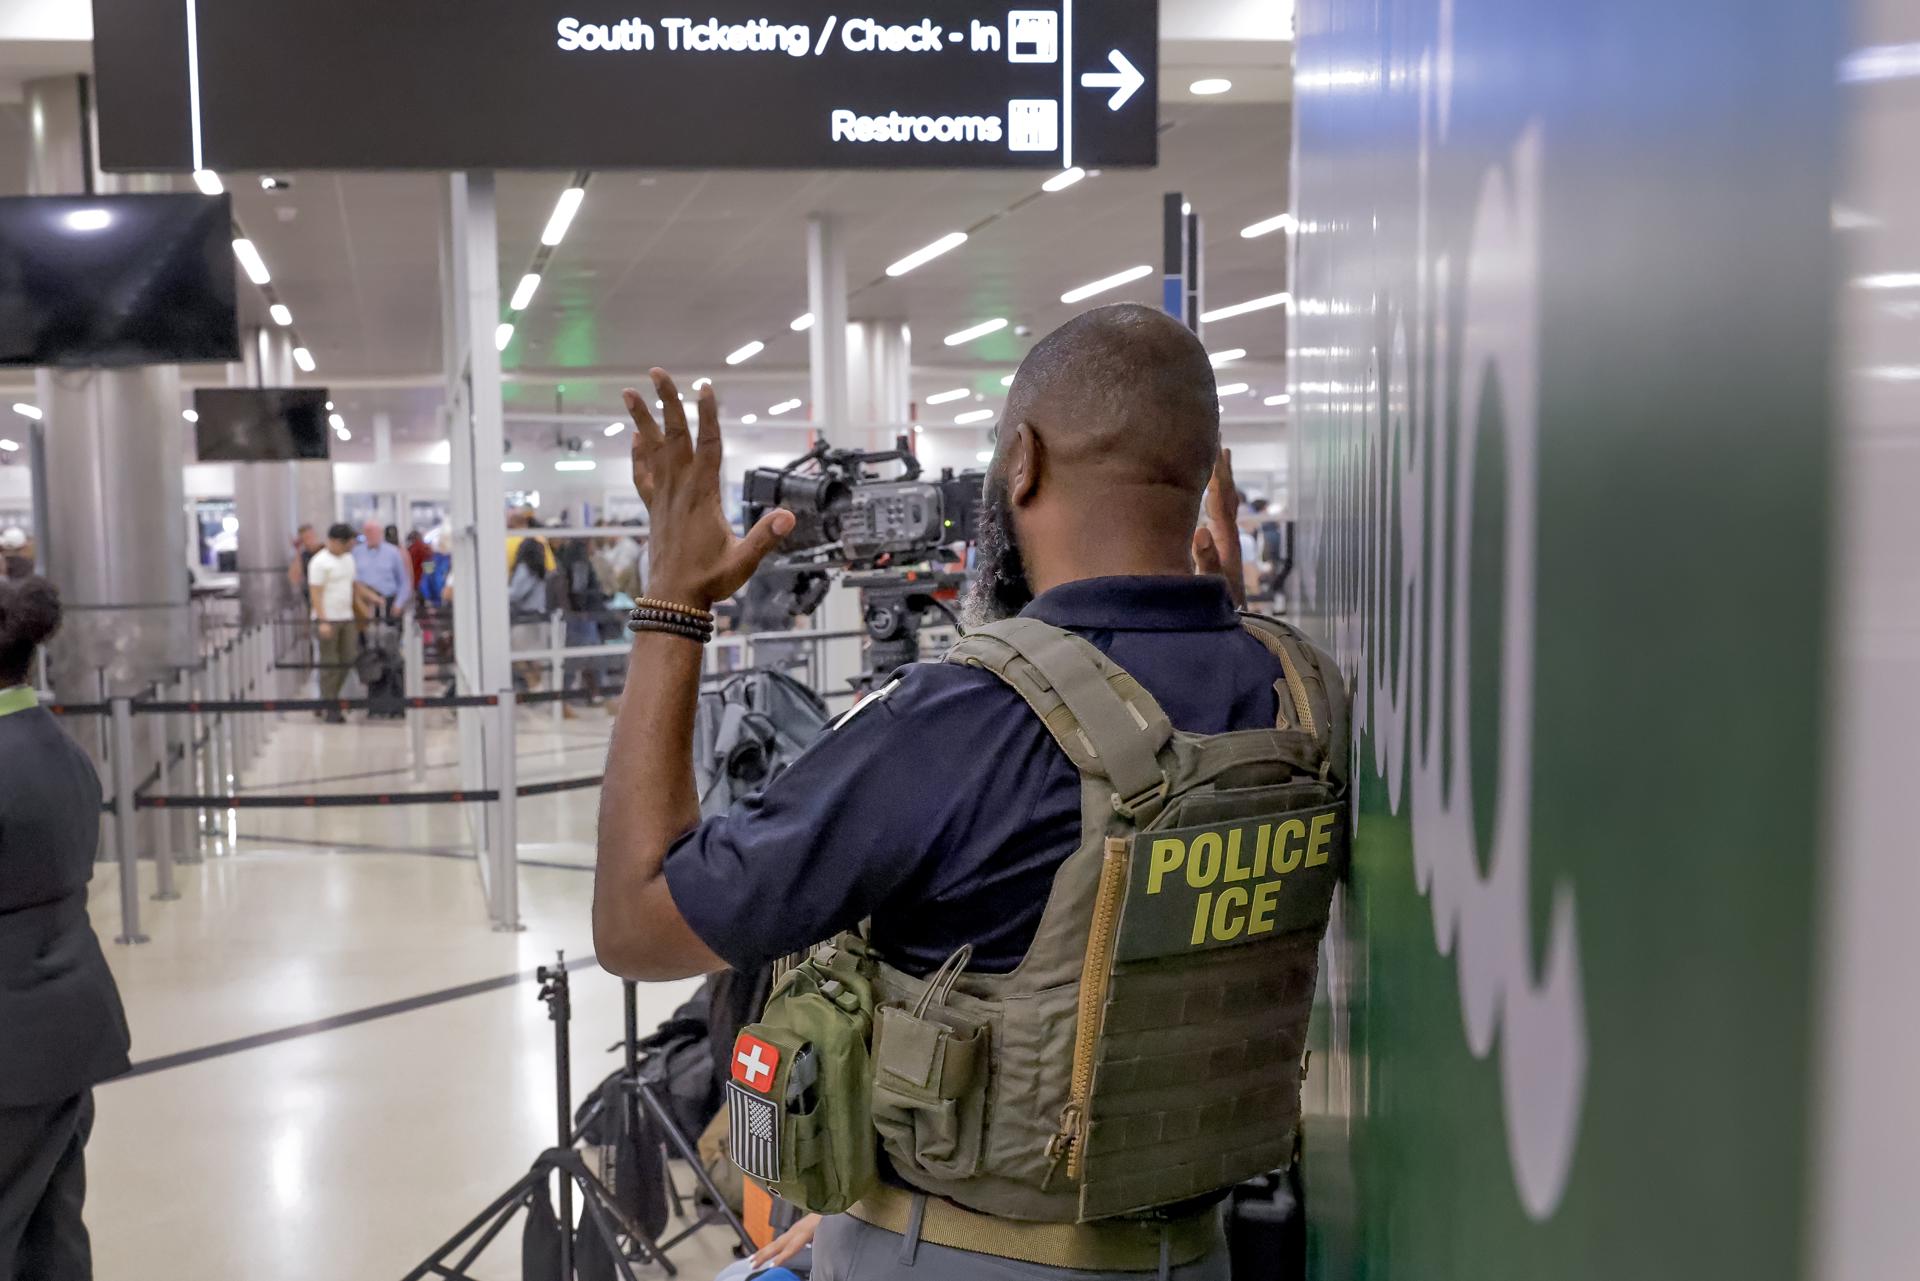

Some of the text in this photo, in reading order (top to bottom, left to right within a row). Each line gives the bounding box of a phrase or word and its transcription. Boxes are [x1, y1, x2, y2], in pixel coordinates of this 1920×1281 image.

[557, 16, 655, 51] South
[660, 17, 810, 57] Ticketing
[831, 109, 1003, 143] Restrooms
[1147, 812, 1336, 895] POLICE
[1191, 880, 1282, 946] ICE
